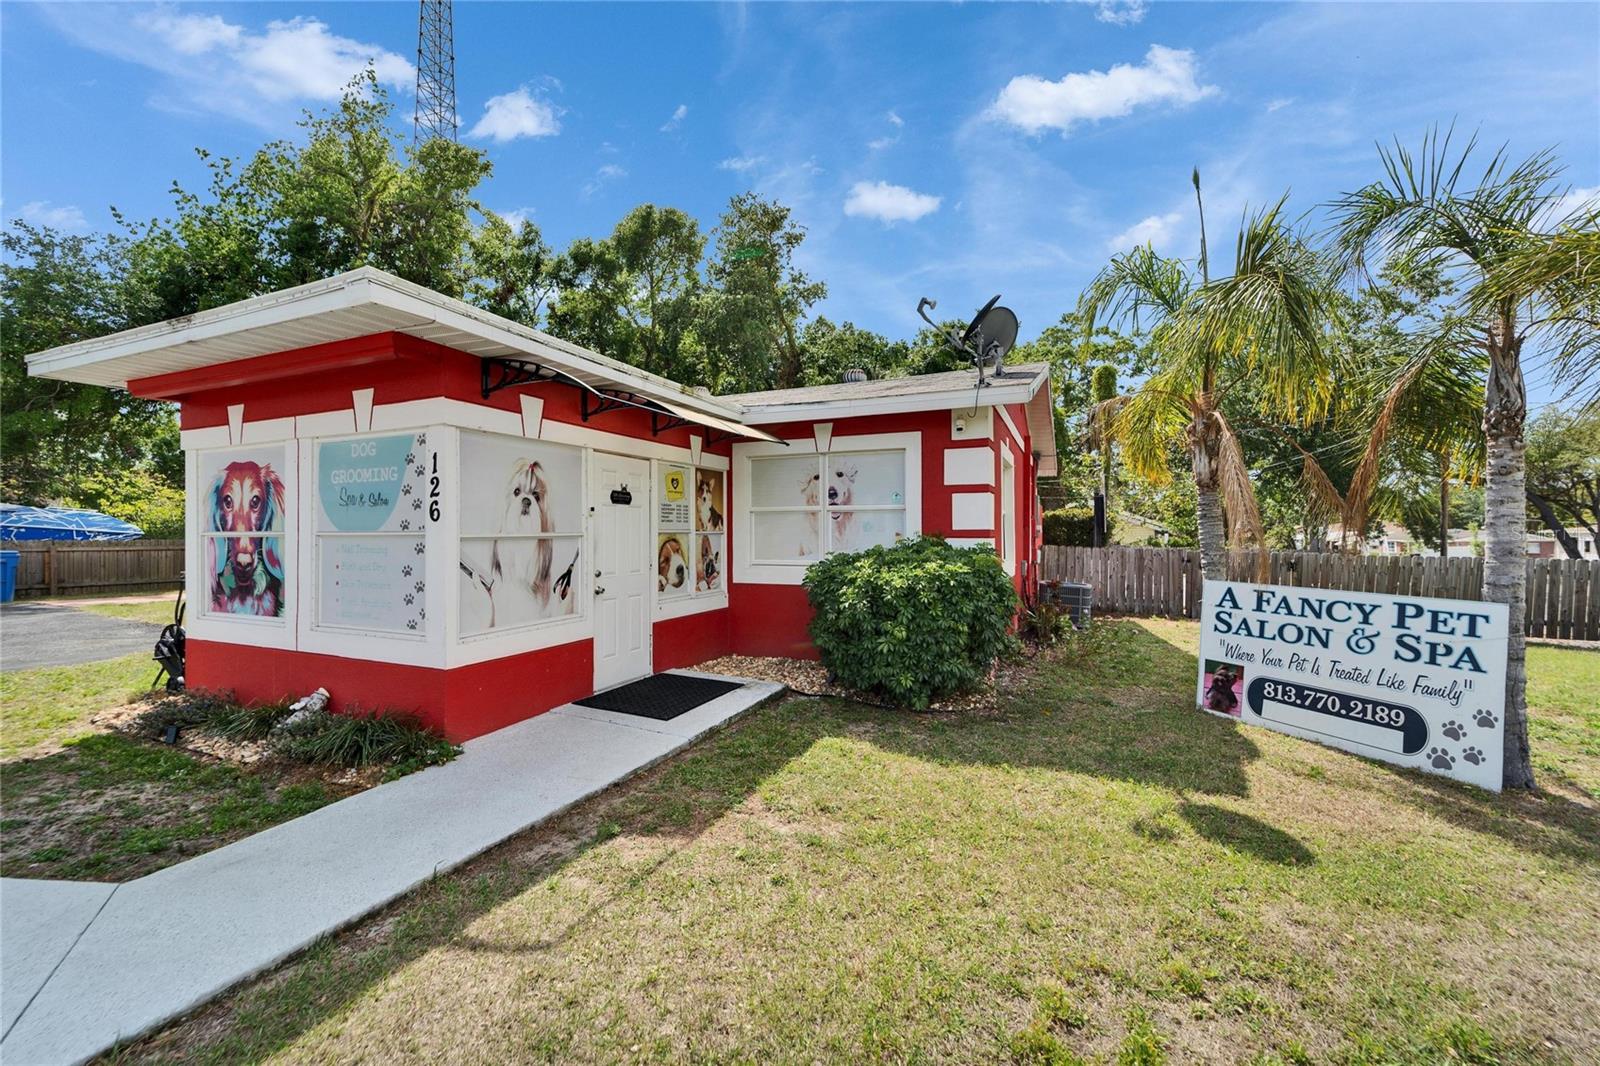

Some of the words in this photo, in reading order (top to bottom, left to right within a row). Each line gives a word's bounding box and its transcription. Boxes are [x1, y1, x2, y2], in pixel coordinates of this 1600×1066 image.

[351, 442, 376, 457] DOG
[330, 466, 398, 485] GROOMING
[429, 452, 440, 522] 126
[1215, 586, 1243, 610] A
[1252, 589, 1381, 626] FANCY
[1391, 601, 1490, 639] PET
[1213, 610, 1333, 649] SALON
[1346, 627, 1381, 655] &
[1394, 633, 1487, 674] SPA
[1260, 648, 1283, 668] Your
[1287, 654, 1309, 674] Pet
[1311, 656, 1321, 676] Is
[1329, 660, 1371, 685] Treated
[1376, 668, 1405, 691] Like
[1263, 681, 1406, 728] 813.770.2189
